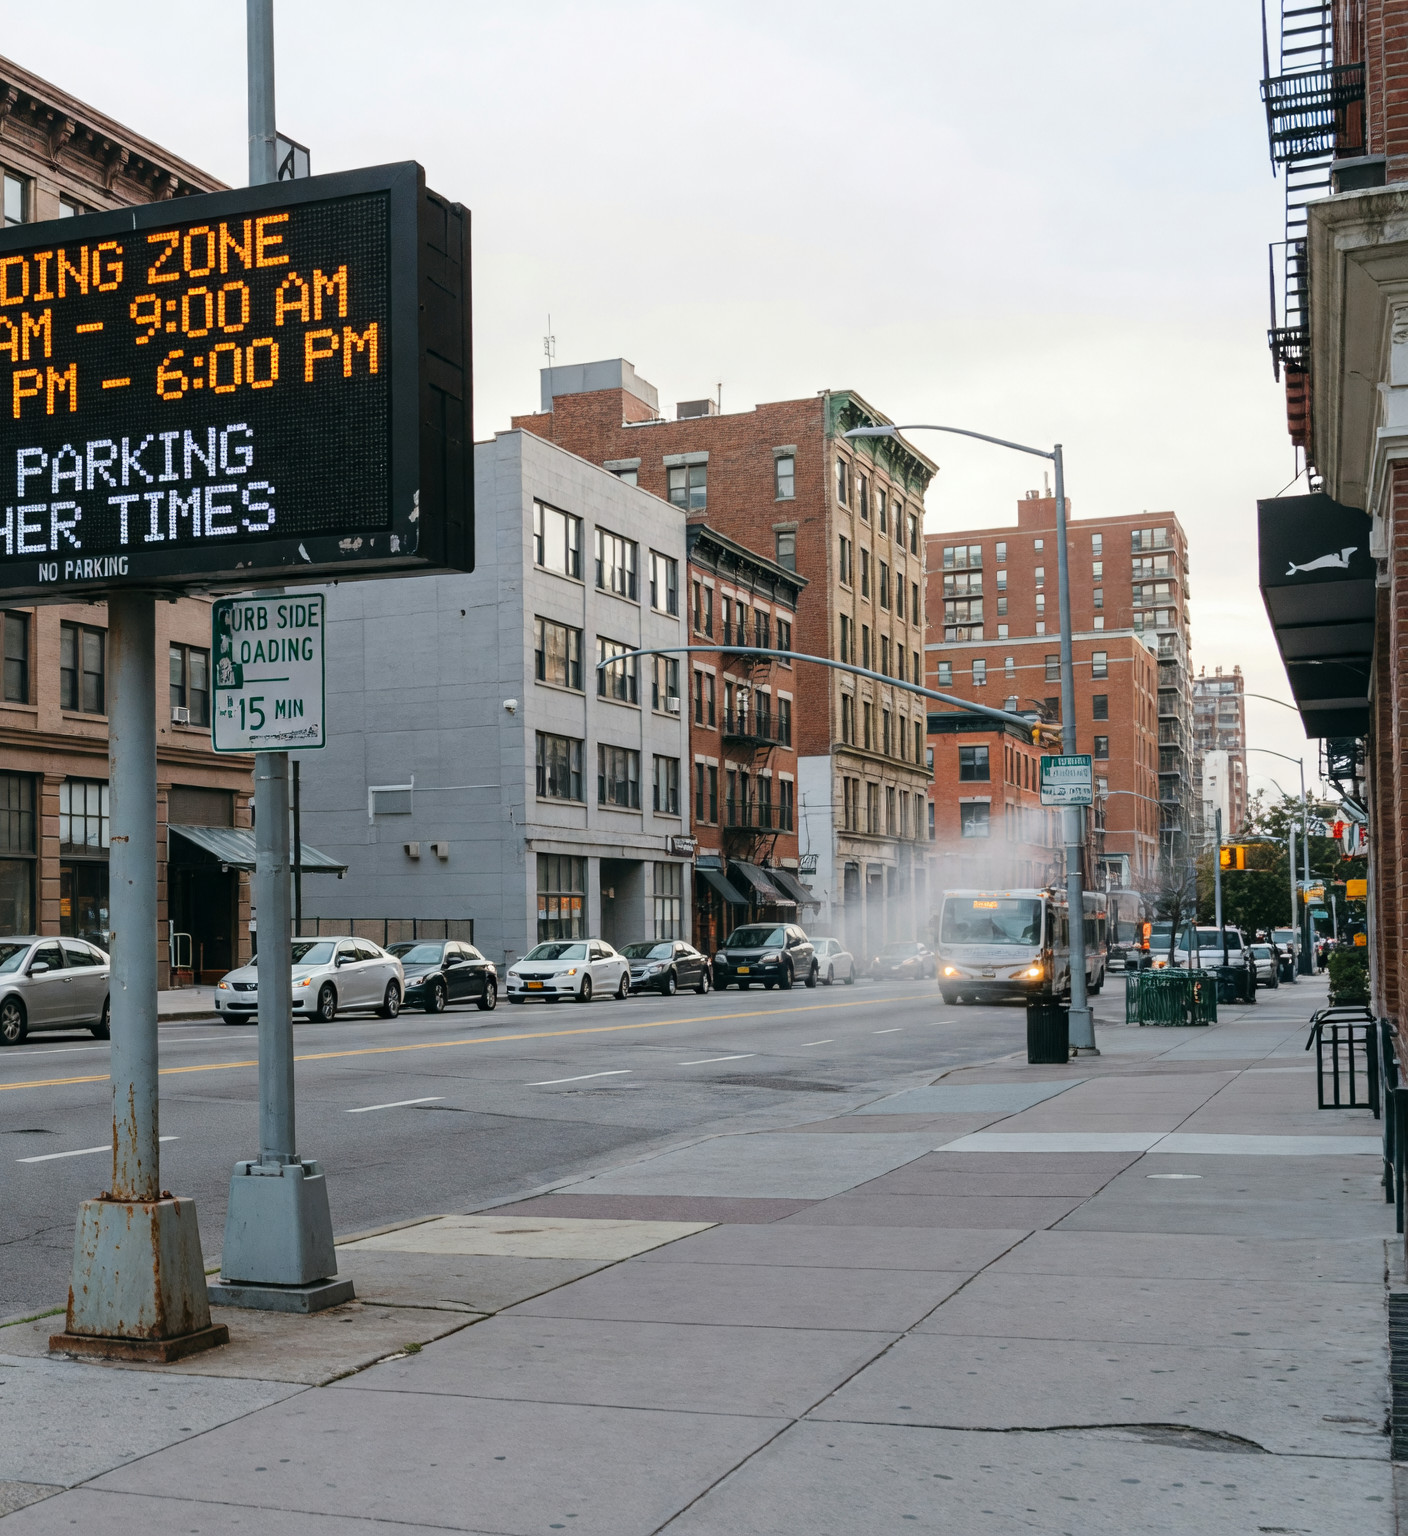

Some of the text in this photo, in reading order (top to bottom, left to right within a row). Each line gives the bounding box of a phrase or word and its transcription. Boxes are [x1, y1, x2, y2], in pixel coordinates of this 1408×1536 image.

[148, 213, 289, 284] ZONE
[130, 280, 249, 344] 9:00
[275, 265, 347, 326] AM
[13, 363, 77, 418] PM
[157, 337, 279, 400] 6:00
[305, 323, 378, 382] PM
[17, 423, 253, 497] PARKING
[108, 481, 275, 544] TIMES
[39, 556, 129, 582] NO PARKING
[277, 603, 319, 629] SIDE
[239, 696, 266, 731] 15
[275, 699, 304, 720] MIN
